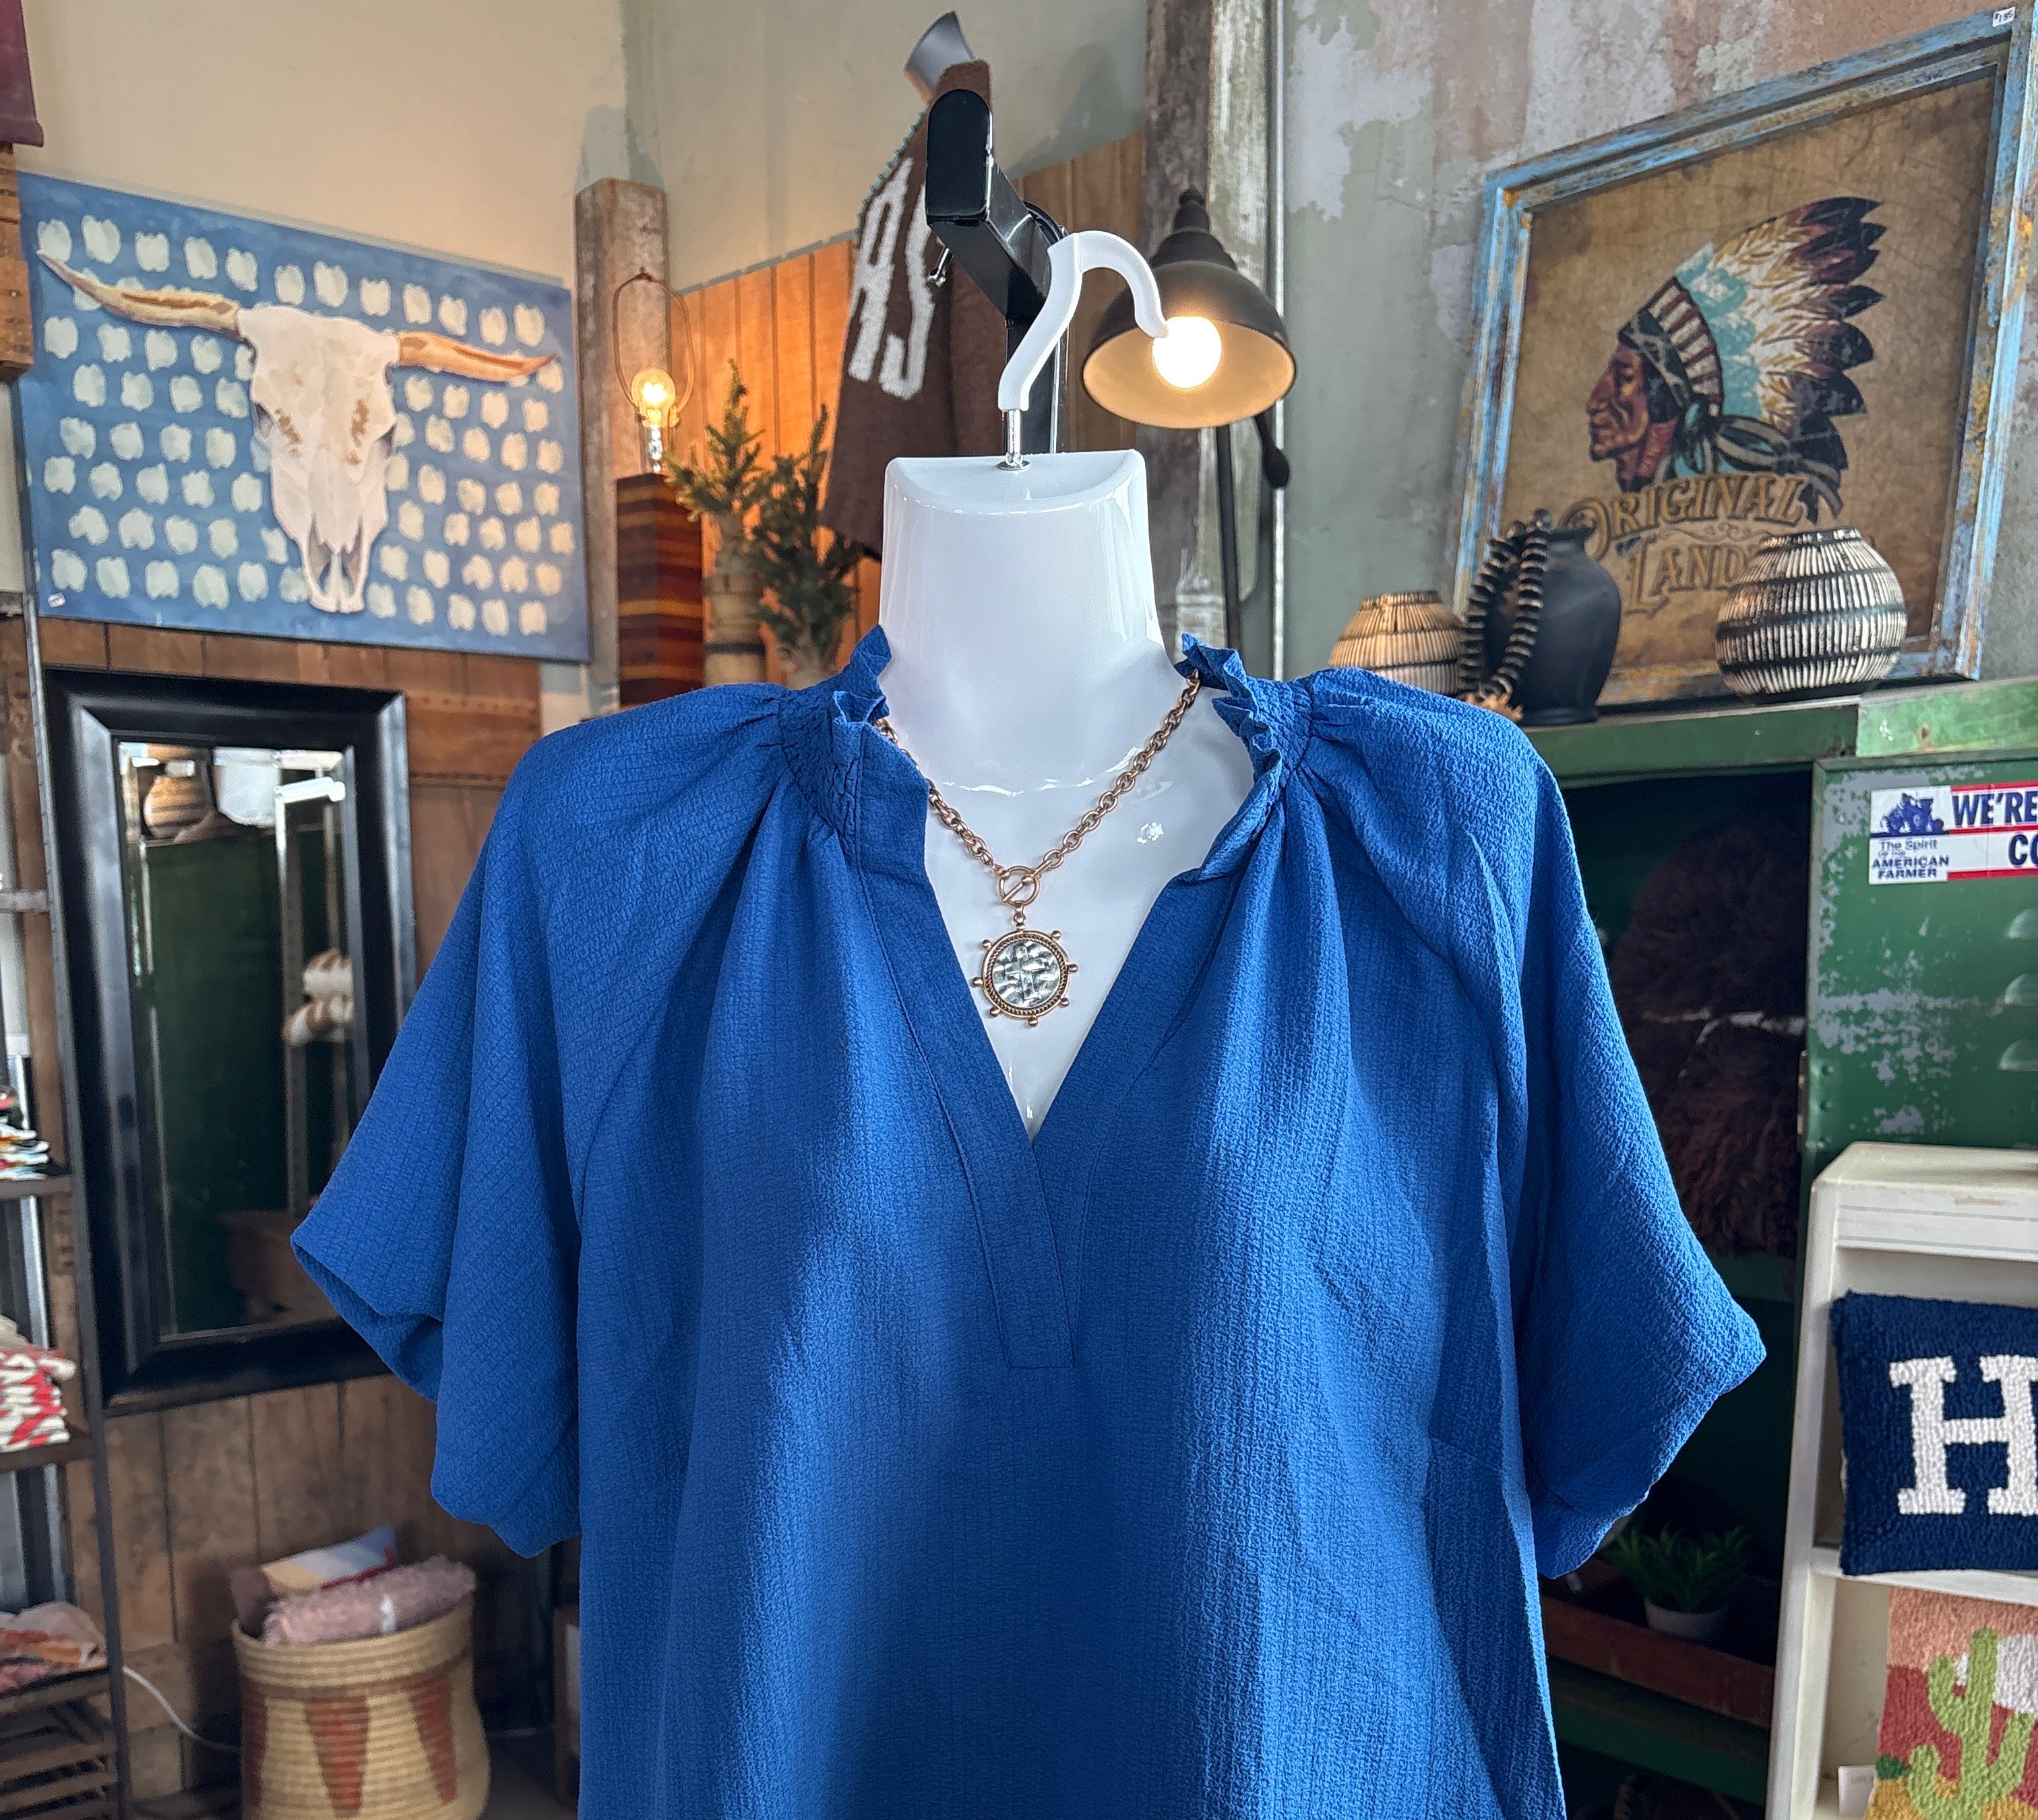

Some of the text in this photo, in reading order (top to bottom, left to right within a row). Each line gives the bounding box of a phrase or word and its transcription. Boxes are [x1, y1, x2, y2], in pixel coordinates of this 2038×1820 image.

[1559, 472, 1810, 562] ORIGINAL
[1952, 790, 2038, 827] WE'RE
[1880, 838, 1938, 852] The Spirit
[1872, 855, 1949, 869] AMERICAN
[1878, 867, 1937, 879] FARMER
[1889, 1354, 2038, 1516] H
